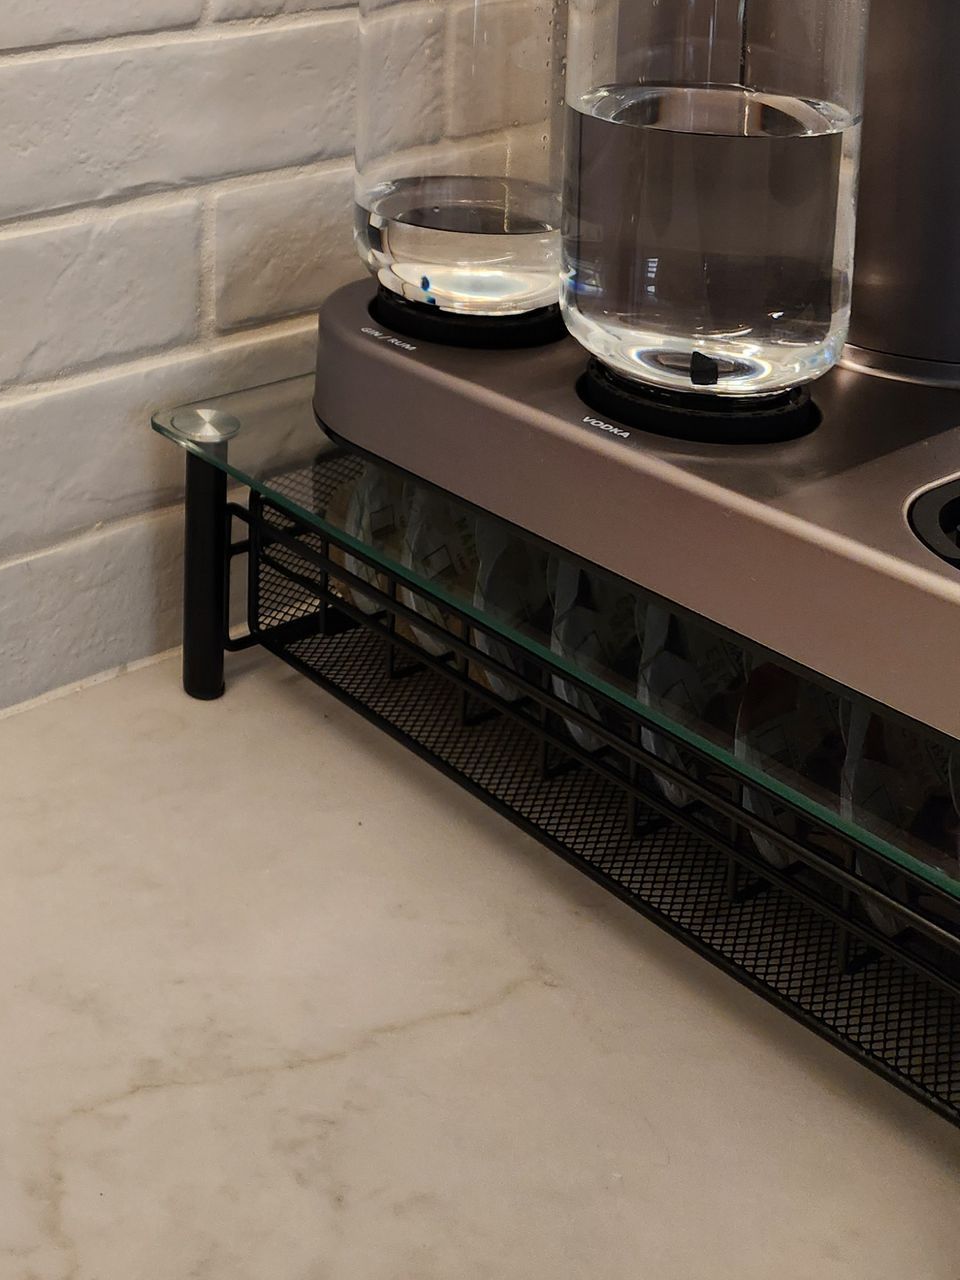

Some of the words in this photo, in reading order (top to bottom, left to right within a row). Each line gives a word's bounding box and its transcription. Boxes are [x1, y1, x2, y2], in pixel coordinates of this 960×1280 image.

[360, 327, 383, 337] GIN
[387, 338, 417, 351] RUM
[582, 416, 630, 438] VODKA
